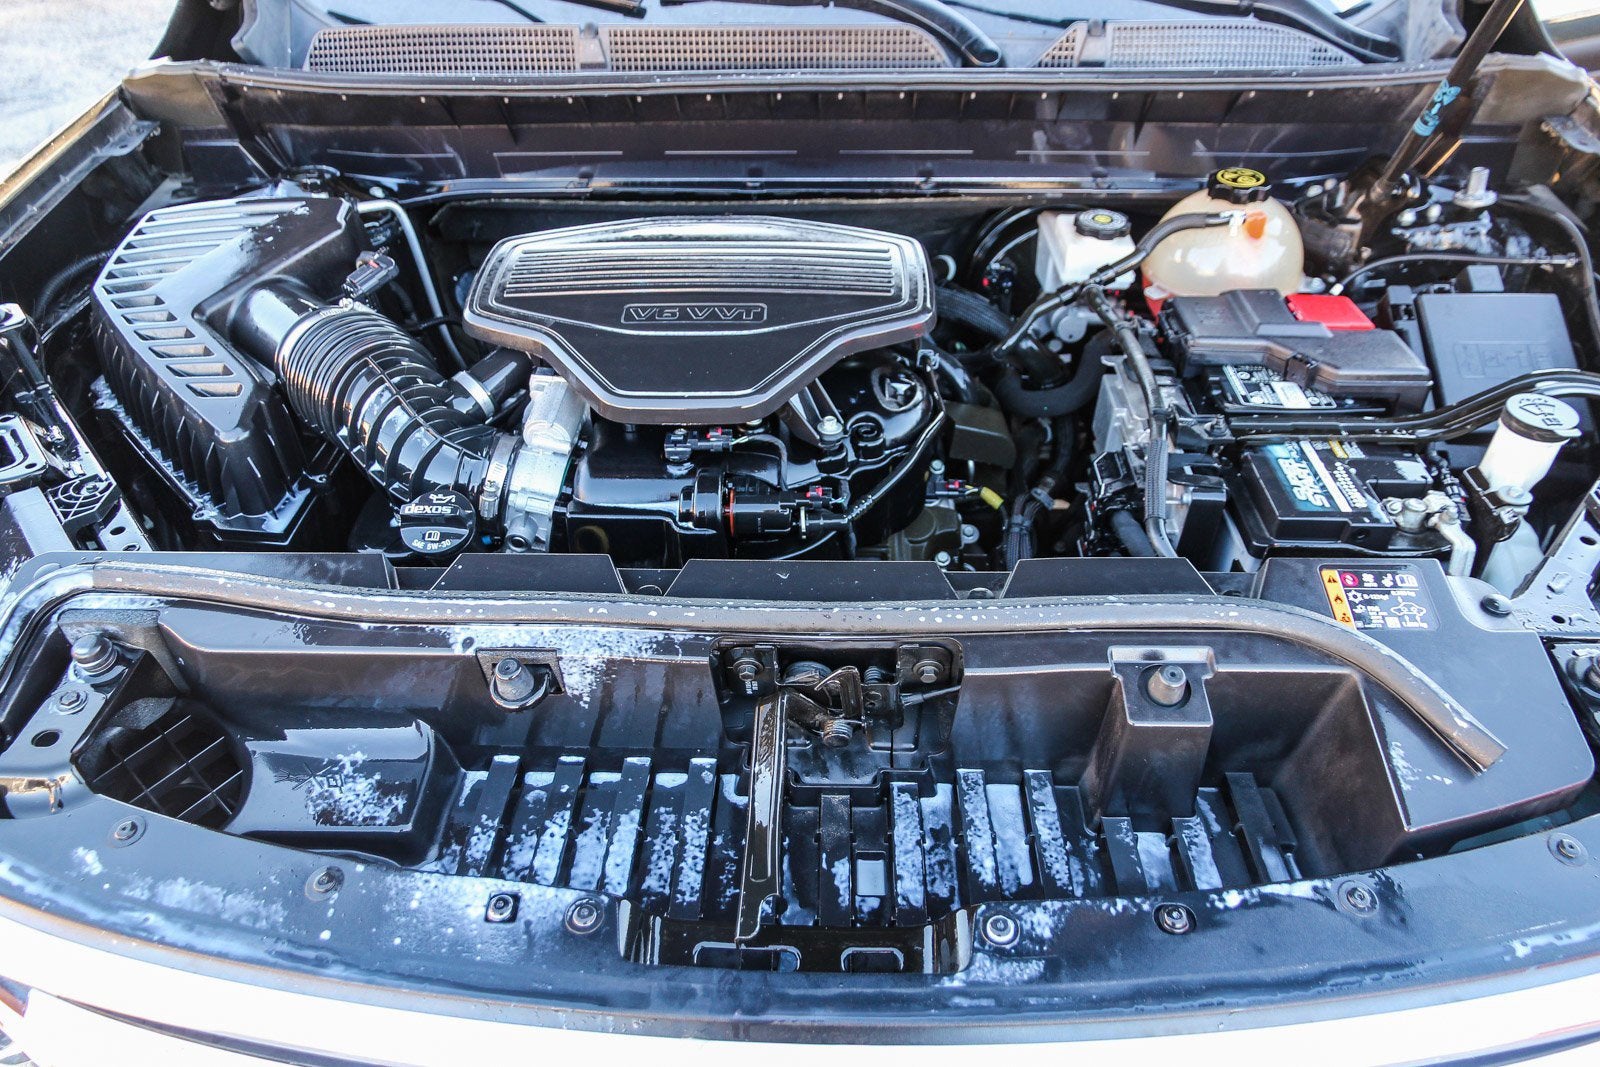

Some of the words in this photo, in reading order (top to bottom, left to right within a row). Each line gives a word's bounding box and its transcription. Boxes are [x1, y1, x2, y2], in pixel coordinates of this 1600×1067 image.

[629, 307, 680, 320] V6
[686, 307, 761, 320] VVT
[404, 503, 454, 514] dexos
[411, 539, 425, 549] SAE
[426, 539, 452, 550] 5W-30
